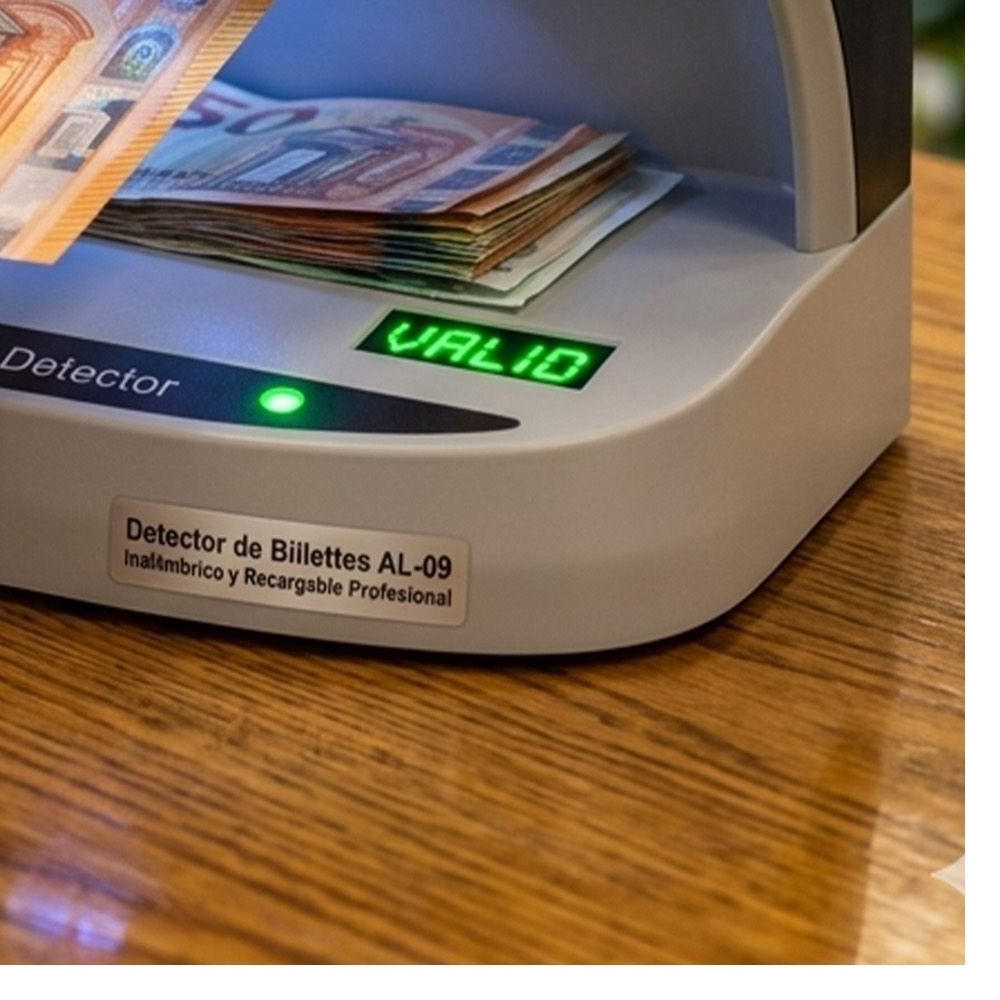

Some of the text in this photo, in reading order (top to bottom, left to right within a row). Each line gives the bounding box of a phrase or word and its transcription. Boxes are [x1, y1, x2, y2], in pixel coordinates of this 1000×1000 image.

[387, 321, 590, 383] VALID
[126, 517, 227, 554] Detector
[233, 534, 262, 559] de
[377, 551, 453, 580] AL-09
[229, 568, 239, 587] y
[348, 580, 453, 607] Profesional
